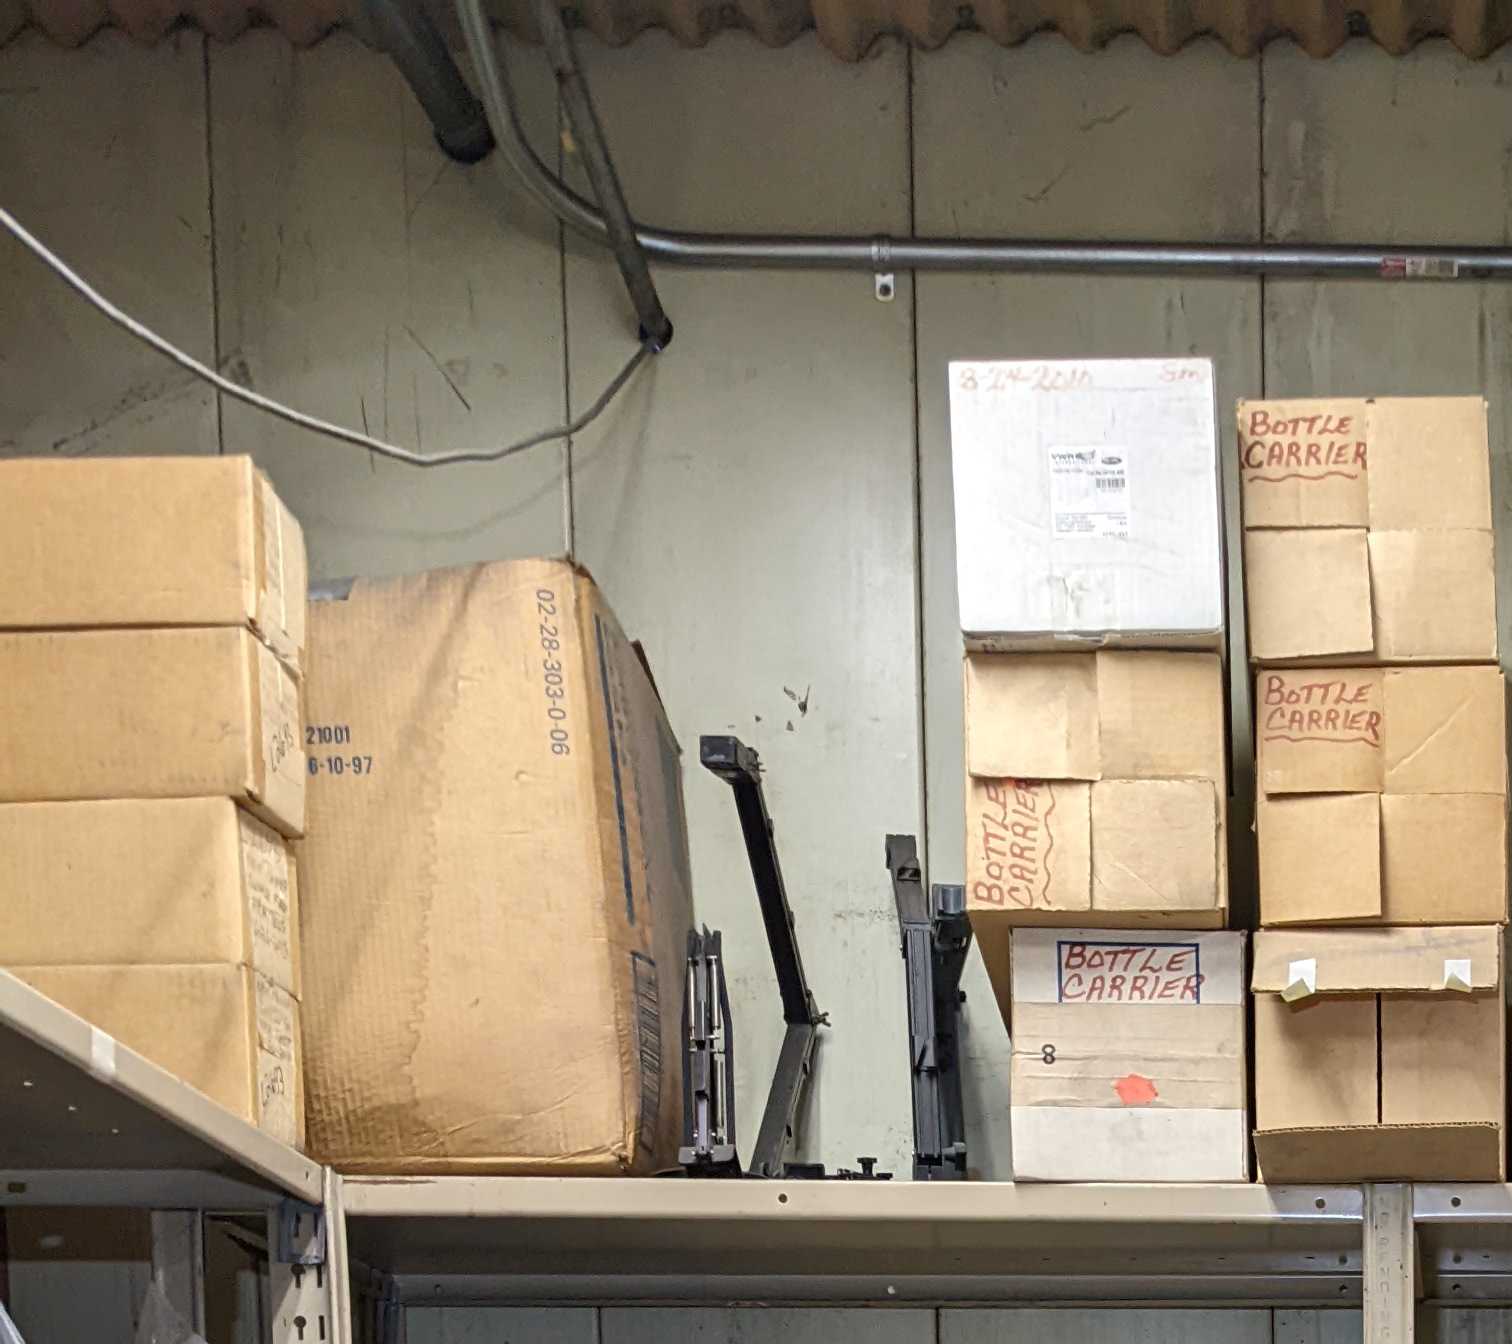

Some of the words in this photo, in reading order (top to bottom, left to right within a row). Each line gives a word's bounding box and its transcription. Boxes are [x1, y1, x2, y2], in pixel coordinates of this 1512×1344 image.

[1250, 410, 1353, 436] BOTTLE
[1244, 440, 1368, 470] CARRIER
[535, 588, 569, 757] 02-28-303-0-06
[1265, 675, 1373, 705] BOTTLE
[1266, 707, 1382, 740] CARRIER
[974, 782, 1009, 905] BOTTLE
[1064, 944, 1198, 973] BOTTLE
[1062, 973, 1205, 1001] CARRIER
[1042, 1043, 1056, 1065] 8
